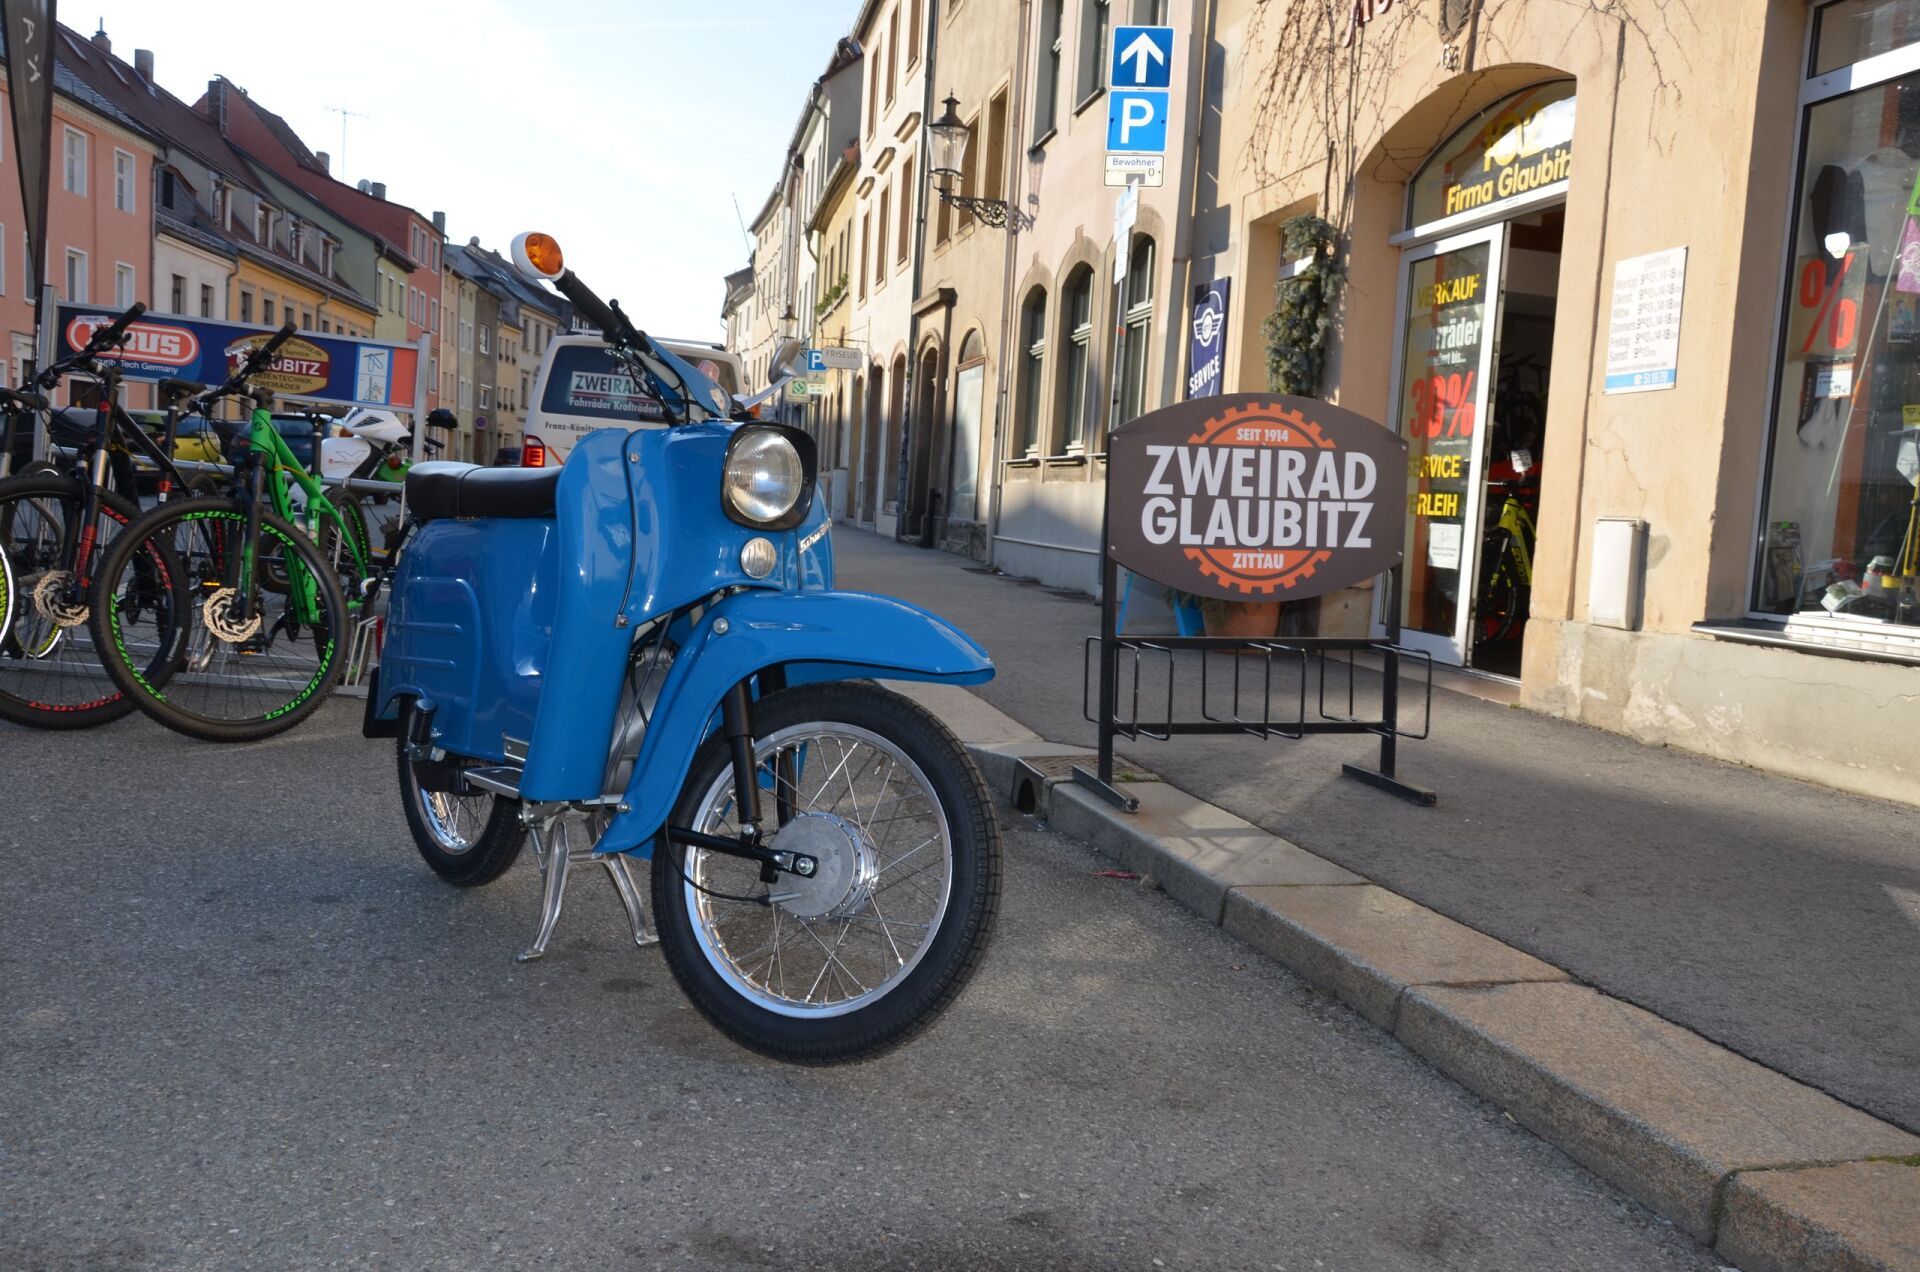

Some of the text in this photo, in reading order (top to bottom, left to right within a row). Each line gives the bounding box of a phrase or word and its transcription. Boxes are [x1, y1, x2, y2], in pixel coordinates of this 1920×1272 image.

[1120, 98, 1155, 144] P
[1112, 157, 1156, 167] Bewohner
[1446, 178, 1495, 215] Firma
[1416, 273, 1480, 309] VERKAUF
[811, 352, 822, 369] P
[825, 349, 858, 360] FRISEUR
[120, 359, 139, 369] Tech
[141, 362, 179, 375] Germany
[1189, 354, 1220, 395] SERVICE
[575, 374, 643, 395] ZWEIRAD
[569, 397, 611, 410] Fahrräder
[613, 401, 657, 414] Krafträder
[1409, 371, 1476, 438] 30%
[1236, 428, 1289, 442] SEIT 1914
[1143, 445, 1377, 500] ZWEIRAD
[1408, 493, 1458, 517] ERLEIH
[1141, 496, 1374, 548] GLAUBITZ
[1232, 553, 1284, 569] ZITTAU
